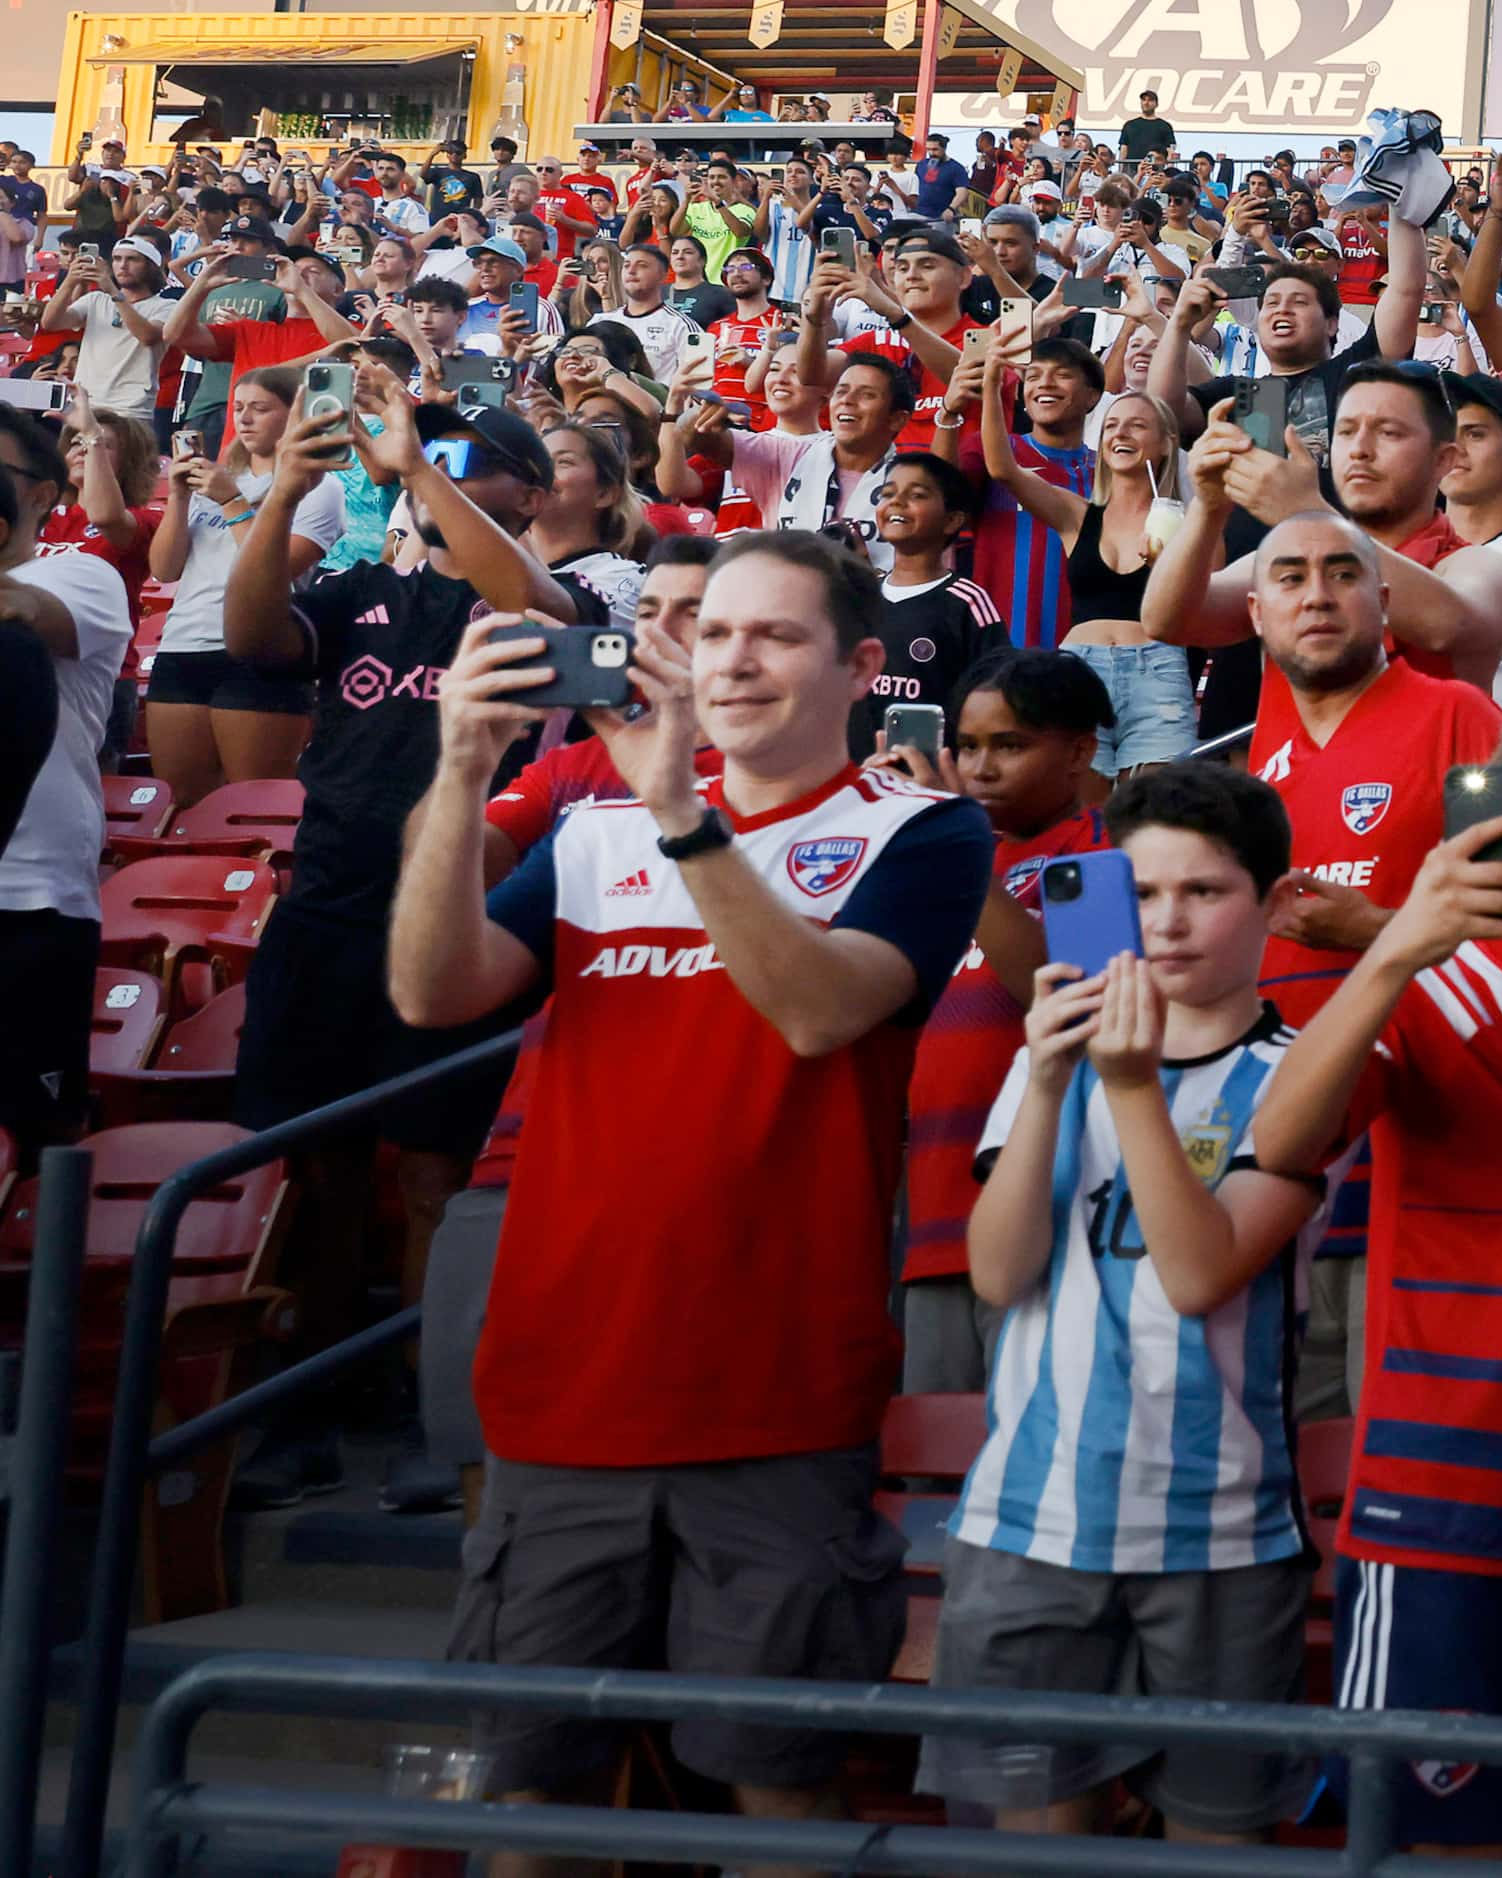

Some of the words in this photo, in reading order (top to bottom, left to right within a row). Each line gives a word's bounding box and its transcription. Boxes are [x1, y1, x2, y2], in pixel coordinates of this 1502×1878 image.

[1358, 786, 1389, 800] DALLAS
[816, 841, 858, 860] DALLAS
[604, 888, 653, 899] adidas
